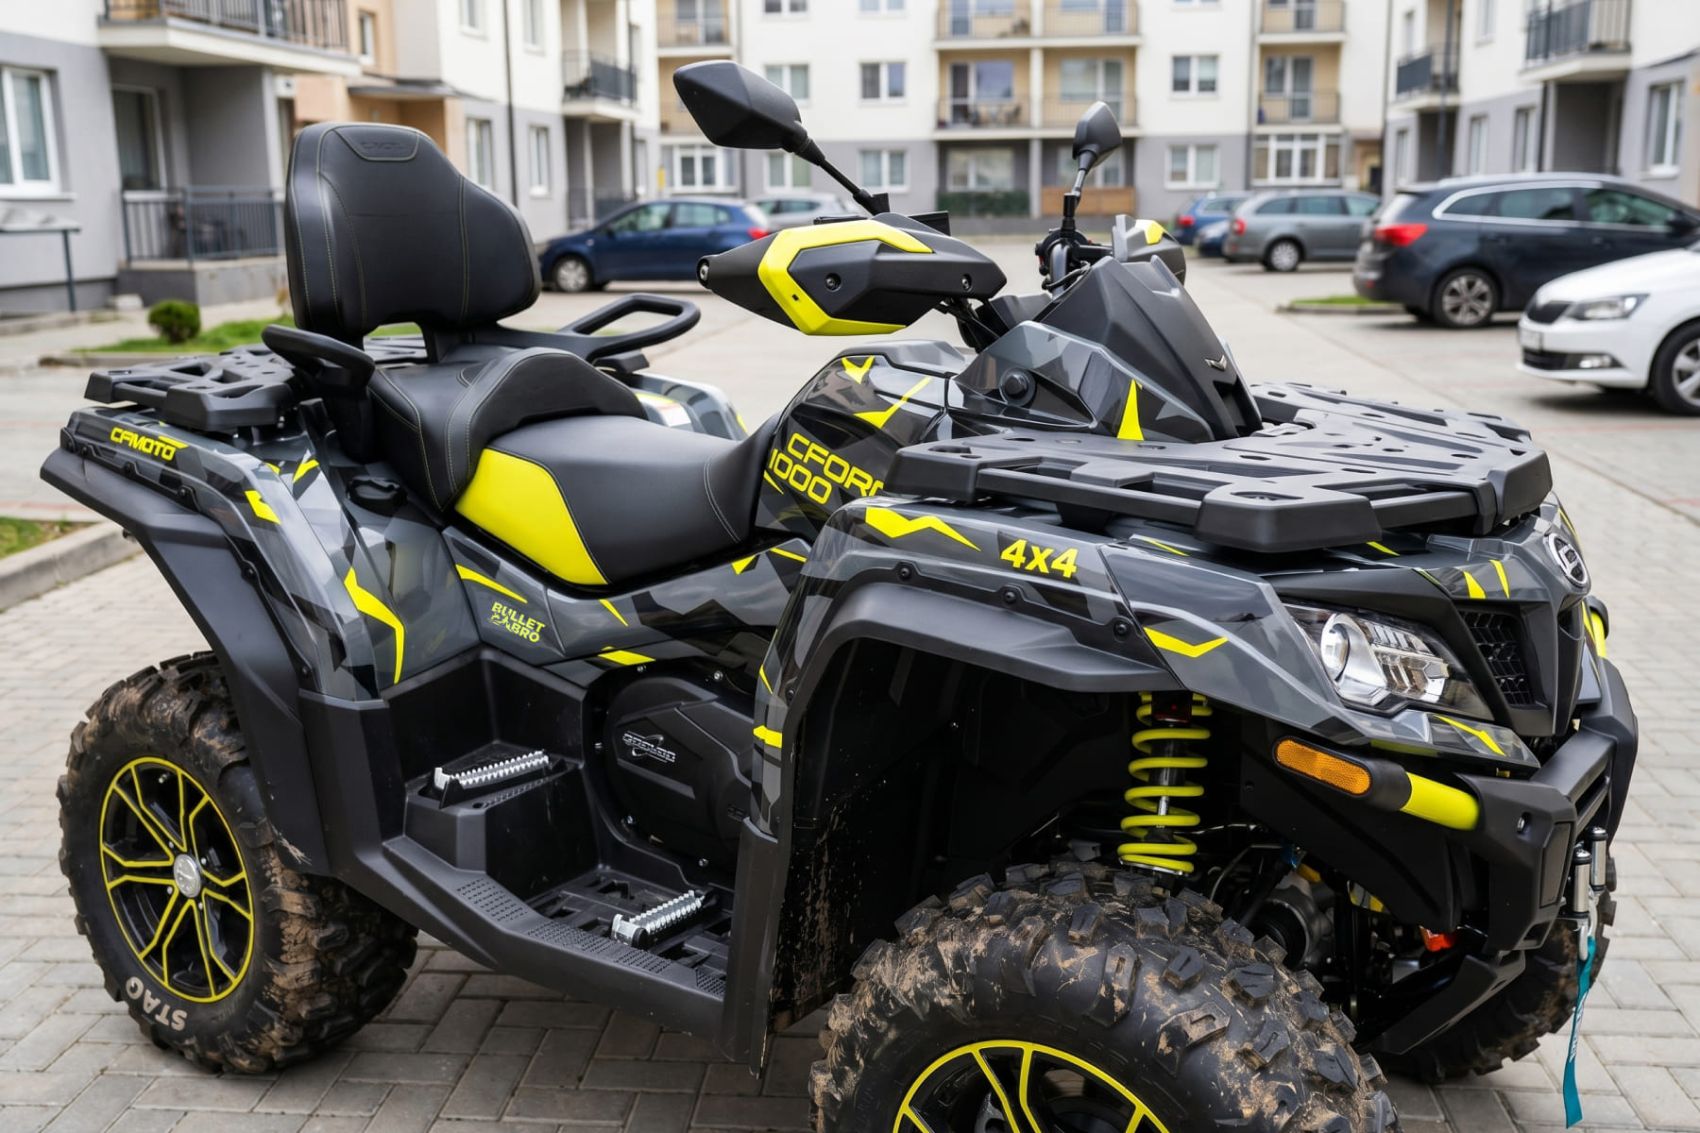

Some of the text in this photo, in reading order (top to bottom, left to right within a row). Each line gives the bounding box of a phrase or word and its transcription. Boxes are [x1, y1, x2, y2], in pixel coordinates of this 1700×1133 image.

[110, 427, 177, 461] CFMOTO
[768, 448, 832, 505] 1000
[491, 601, 546, 633] BULLET
[125, 976, 188, 1031] STAG
